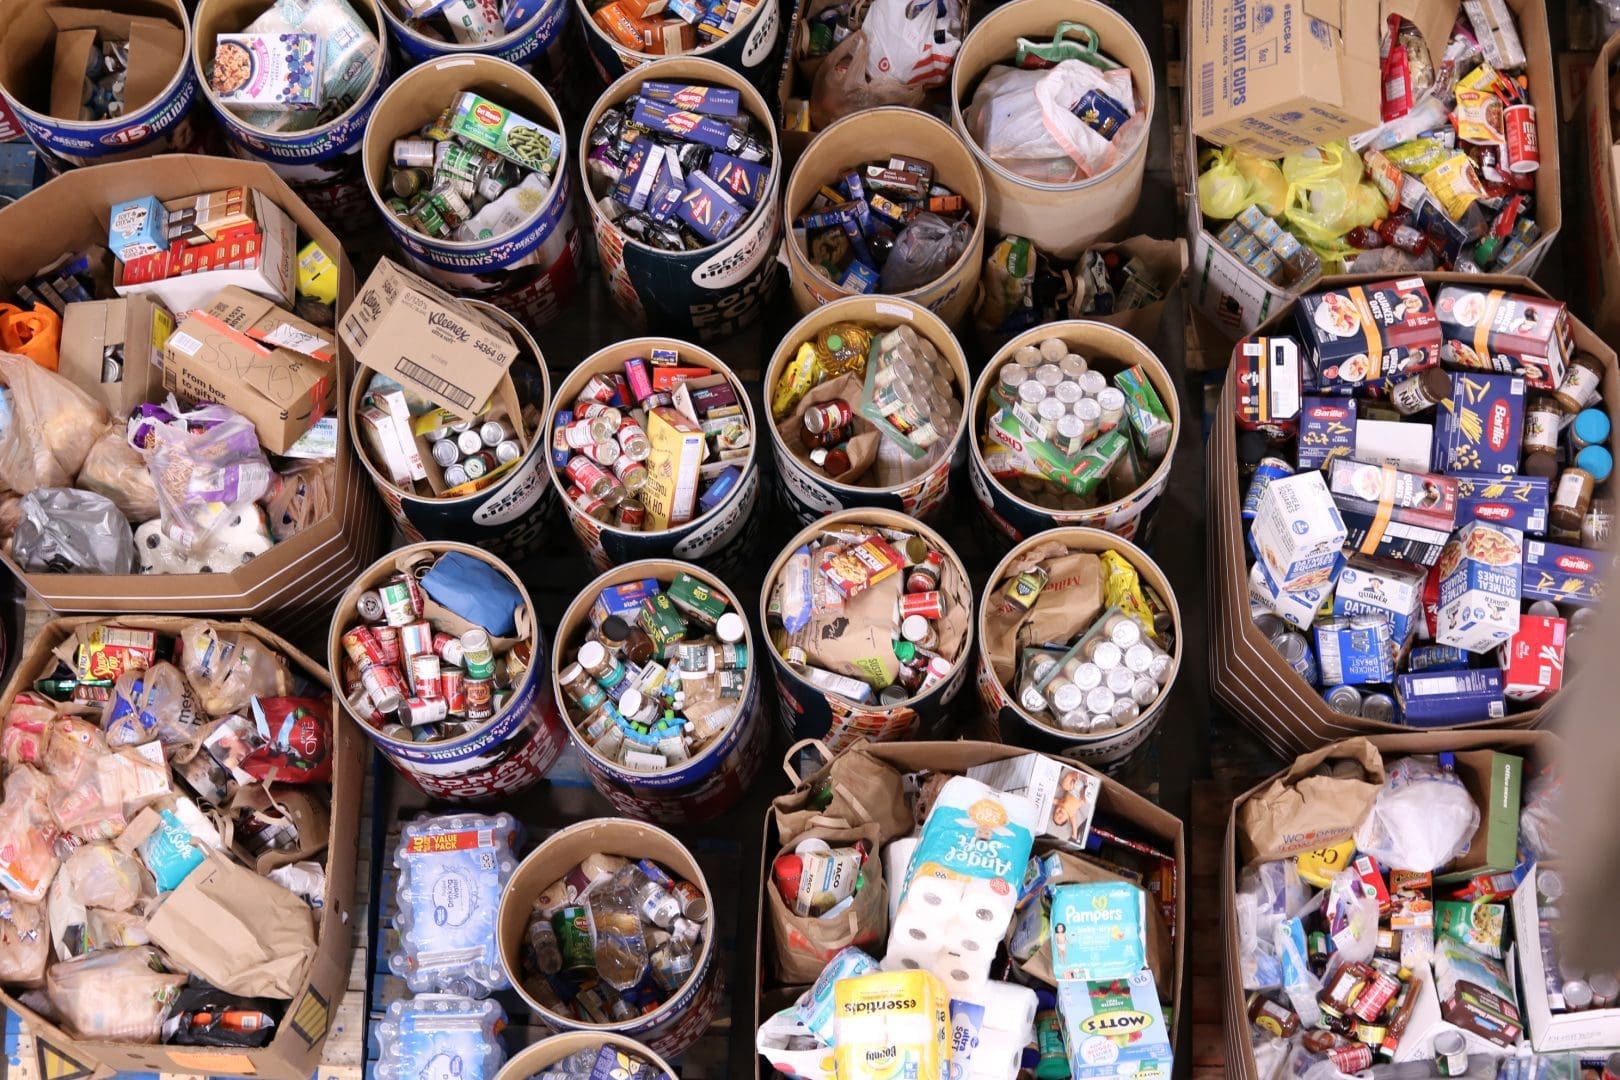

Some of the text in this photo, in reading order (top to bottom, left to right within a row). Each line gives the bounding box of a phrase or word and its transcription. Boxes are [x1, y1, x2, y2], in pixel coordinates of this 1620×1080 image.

[1233, 0, 1246, 106] APER HOT CUPS
[116, 126, 146, 143] 15
[151, 82, 194, 134] HOLIDAYS
[271, 140, 333, 158] HOLIDAYS
[431, 253, 494, 267] HOLIDAYS
[1369, 300, 1384, 320] OATS
[1374, 291, 1394, 326] QUAKER
[428, 311, 470, 343] Kleenex
[473, 339, 507, 364] 54364 01
[182, 368, 227, 400] From box
[182, 379, 213, 402] to gift
[1314, 408, 1345, 418] Barilla
[1492, 404, 1507, 448] Barilla
[995, 430, 1023, 452] Chex
[1501, 464, 1516, 474] 6
[1279, 486, 1296, 514] SQUARES
[1284, 483, 1301, 512] OATMEAL
[1478, 506, 1510, 519] Barilla
[1560, 558, 1591, 571] Barilla
[1478, 570, 1517, 584] SQUARES
[1358, 591, 1388, 604] QUAKER
[1478, 580, 1517, 598] OATMEAL
[93, 650, 116, 680] Stove
[1349, 665, 1380, 674] CHICKEN
[1351, 657, 1379, 667] BREAST
[304, 720, 317, 755] ONE
[432, 735, 494, 761] HOLIDAYS
[1504, 764, 1512, 786] Office
[412, 837, 424, 852] 40
[433, 833, 458, 843] VALUE
[434, 841, 457, 850] PACK
[958, 833, 1005, 859] Soft
[944, 845, 1013, 877] Angel
[806, 873, 814, 894] TACO
[833, 861, 844, 889] TACO
[1065, 905, 1124, 924] Pampers
[844, 998, 917, 1014] essentials
[951, 1025, 964, 1053] SOFT
[958, 1028, 971, 1052] ultra
[865, 1045, 897, 1062] Bounty
